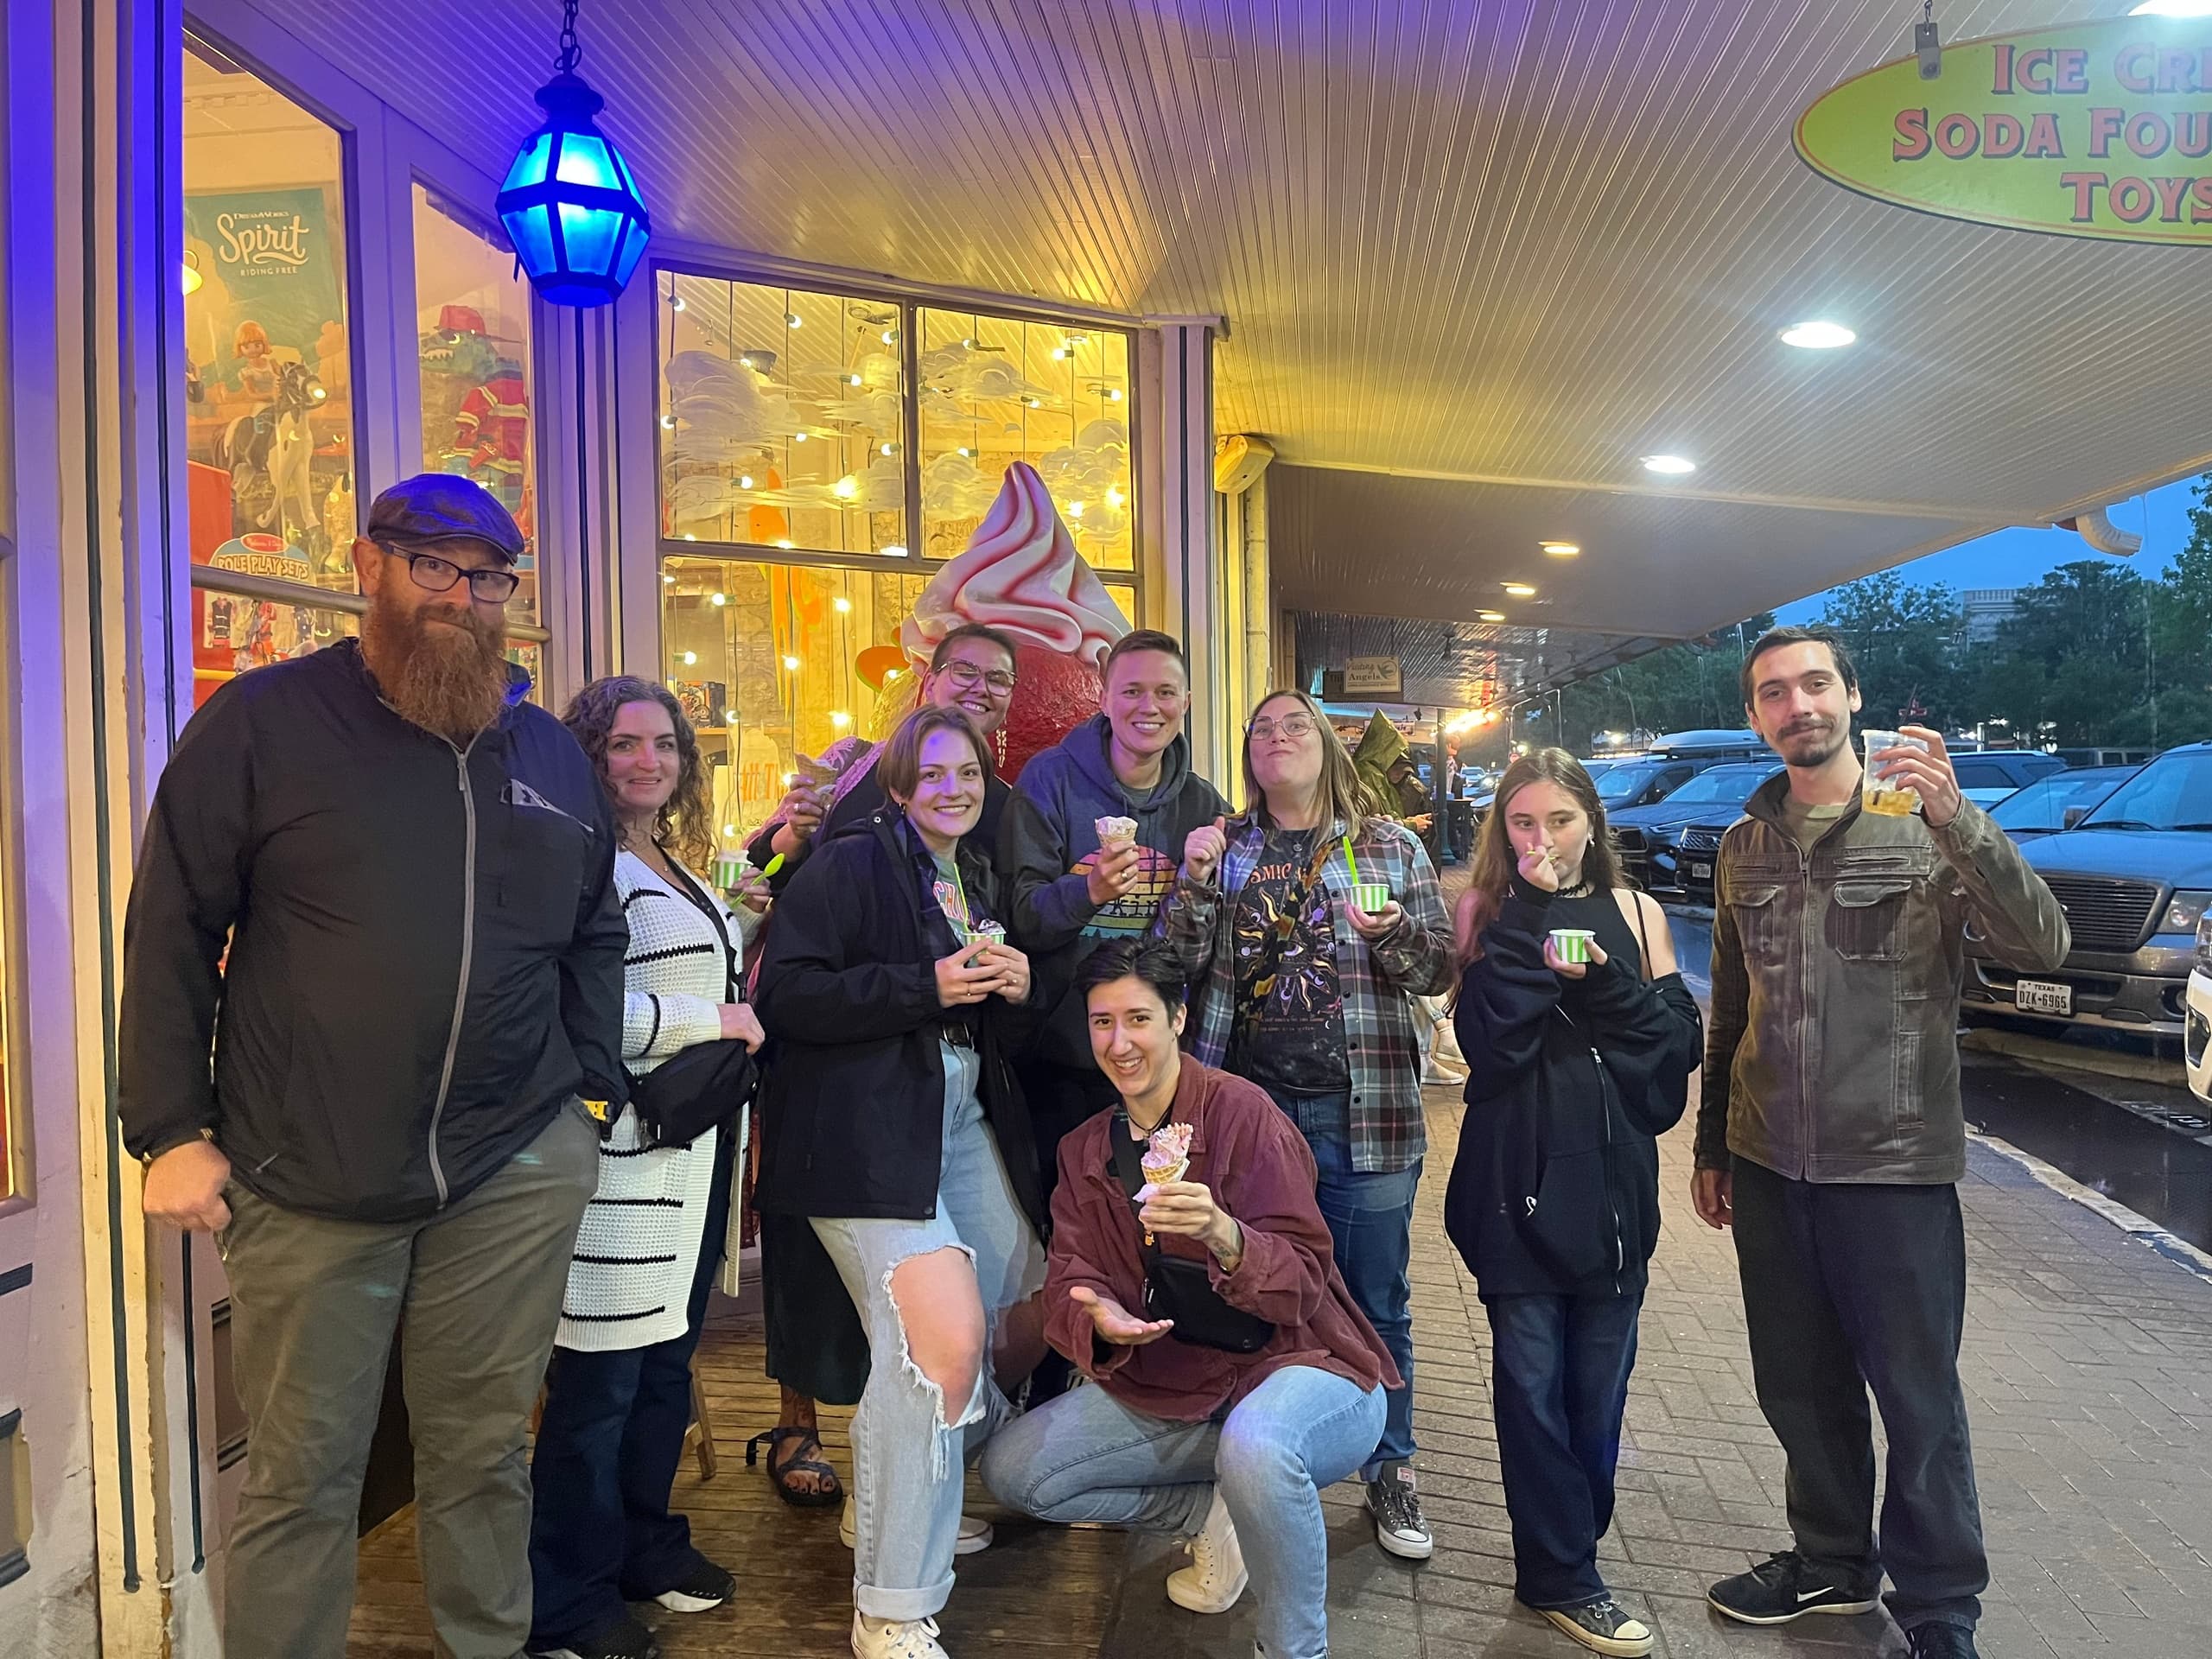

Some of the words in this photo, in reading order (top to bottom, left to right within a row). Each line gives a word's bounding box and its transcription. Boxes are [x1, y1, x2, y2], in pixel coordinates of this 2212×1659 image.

[1991, 43, 2089, 96] ICE
[1892, 107, 2067, 162] SODA
[216, 213, 309, 265] Spirit
[240, 268, 274, 276] RIDING
[276, 266, 298, 275] FREE
[217, 555, 247, 572] ROLE
[250, 555, 279, 575] PLAY
[281, 558, 309, 581] SETS
[1348, 673, 1382, 682] Angels
